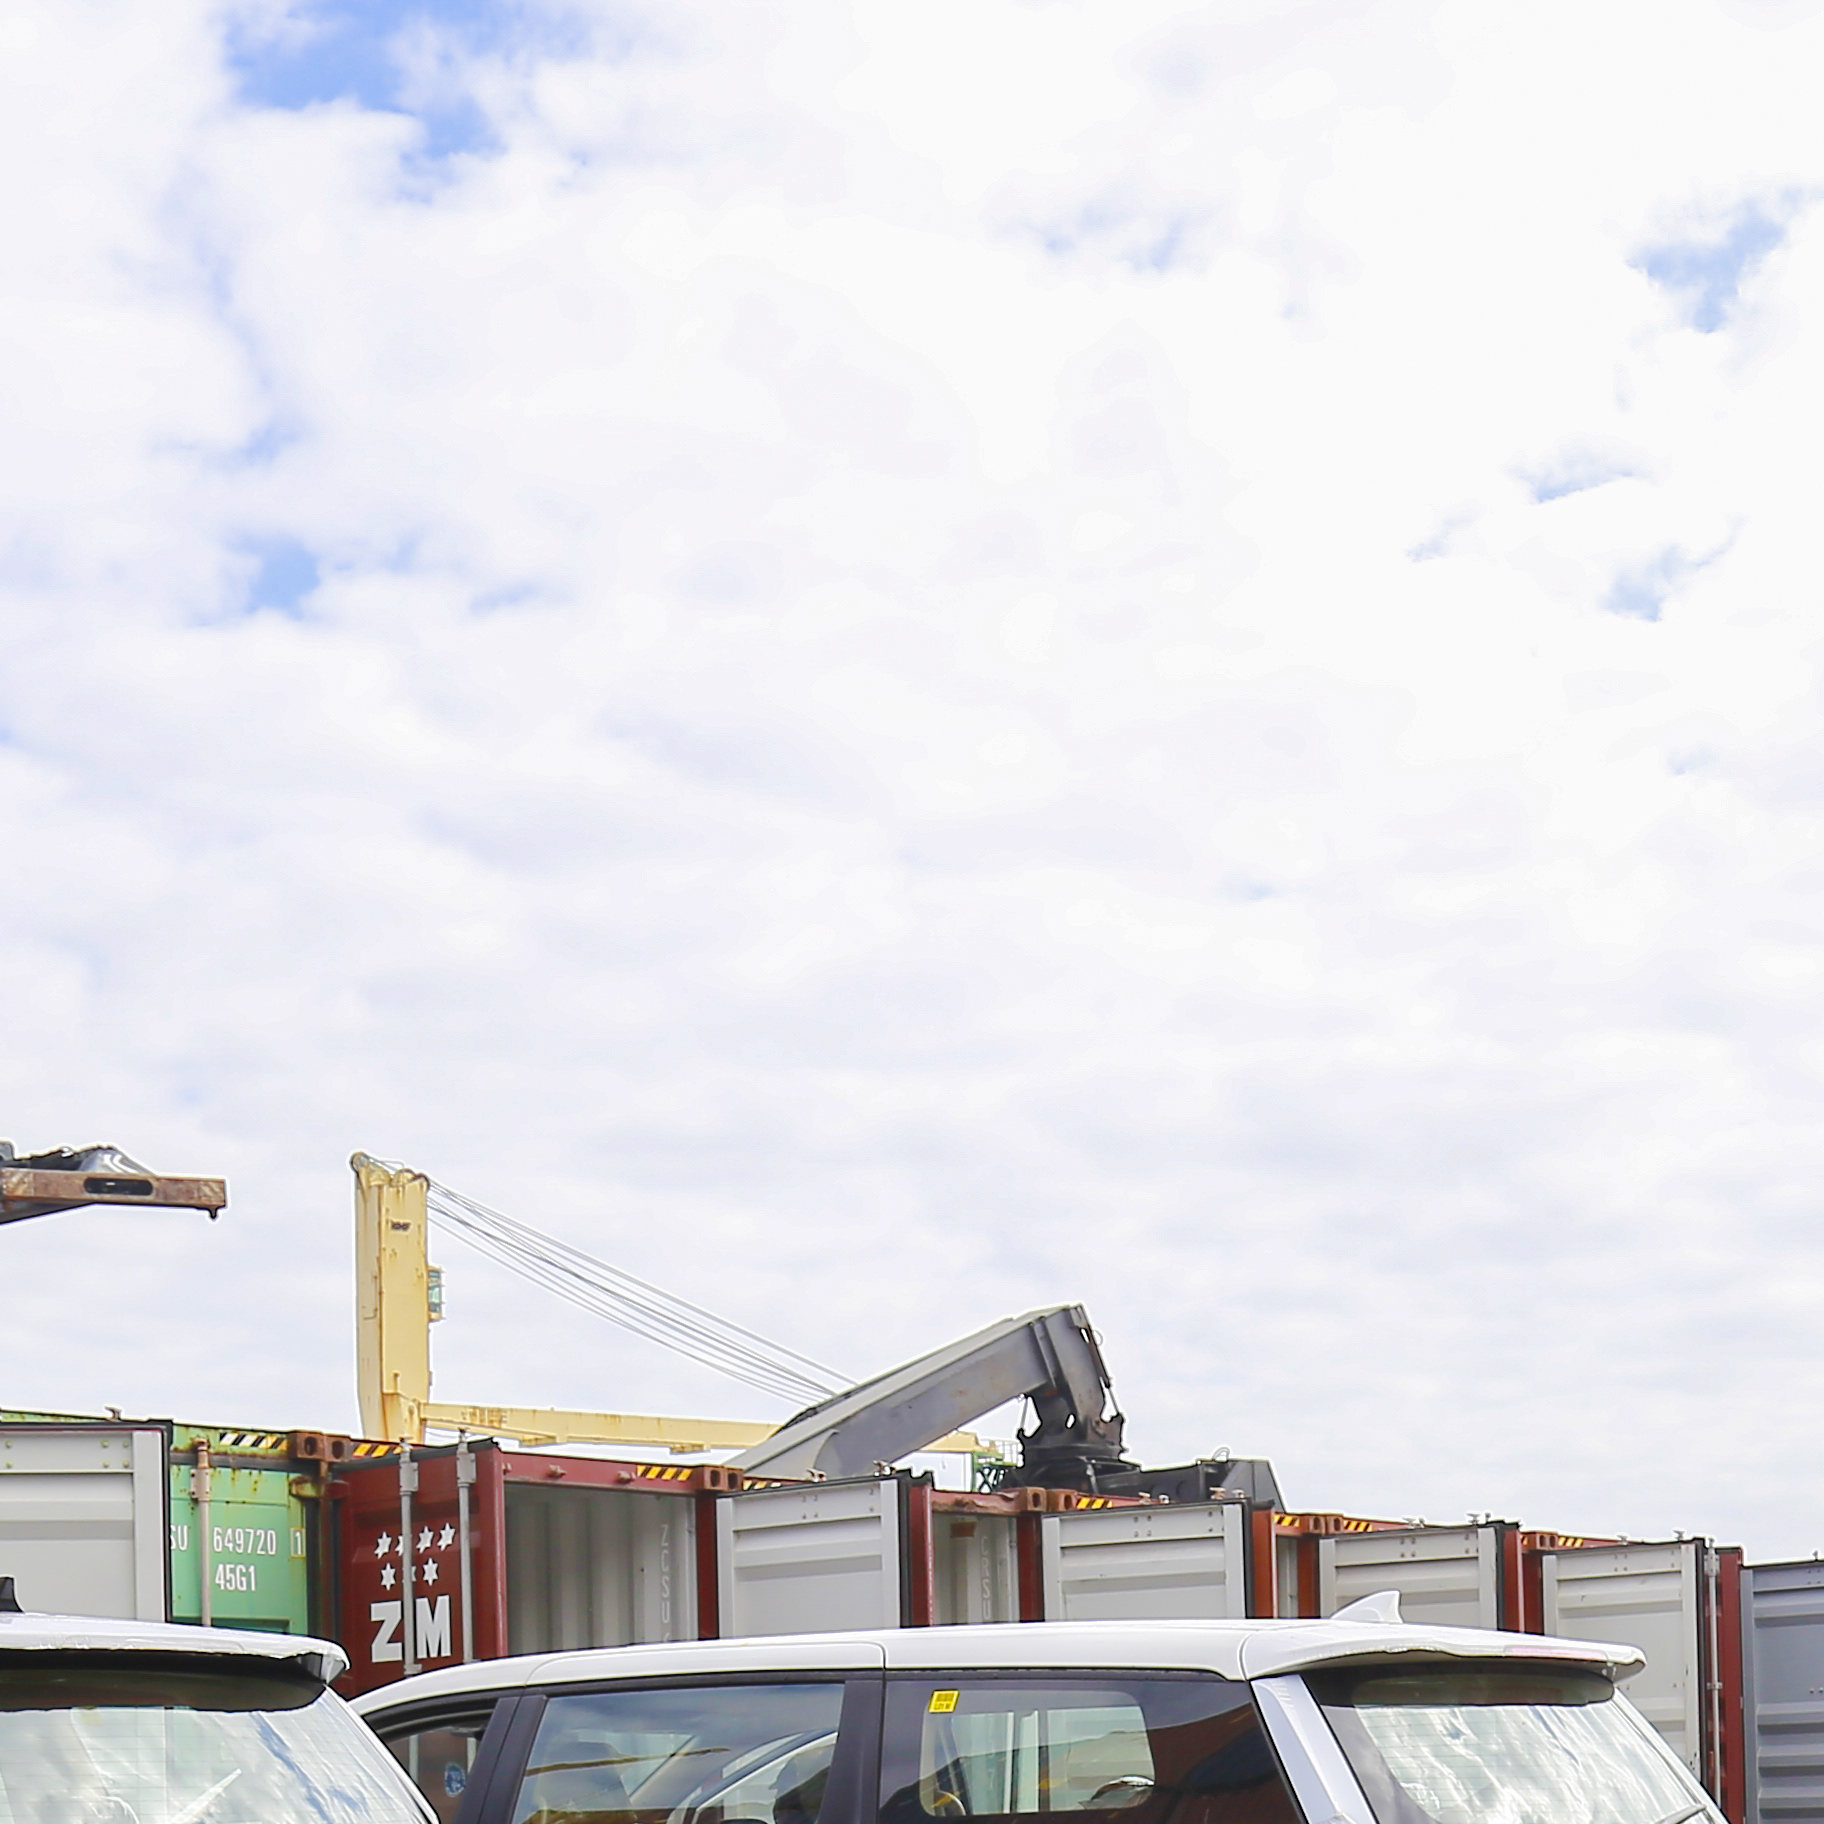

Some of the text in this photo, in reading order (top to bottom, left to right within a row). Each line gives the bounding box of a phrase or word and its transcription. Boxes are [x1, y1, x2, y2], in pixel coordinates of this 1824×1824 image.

[212, 1526, 277, 1556] 649720
[294, 1531, 303, 1556] 1
[661, 1524, 671, 1624] ZCSU
[214, 1563, 257, 1592] 45G1
[981, 1536, 992, 1620] CRSU
[370, 1594, 452, 1664] ZM
